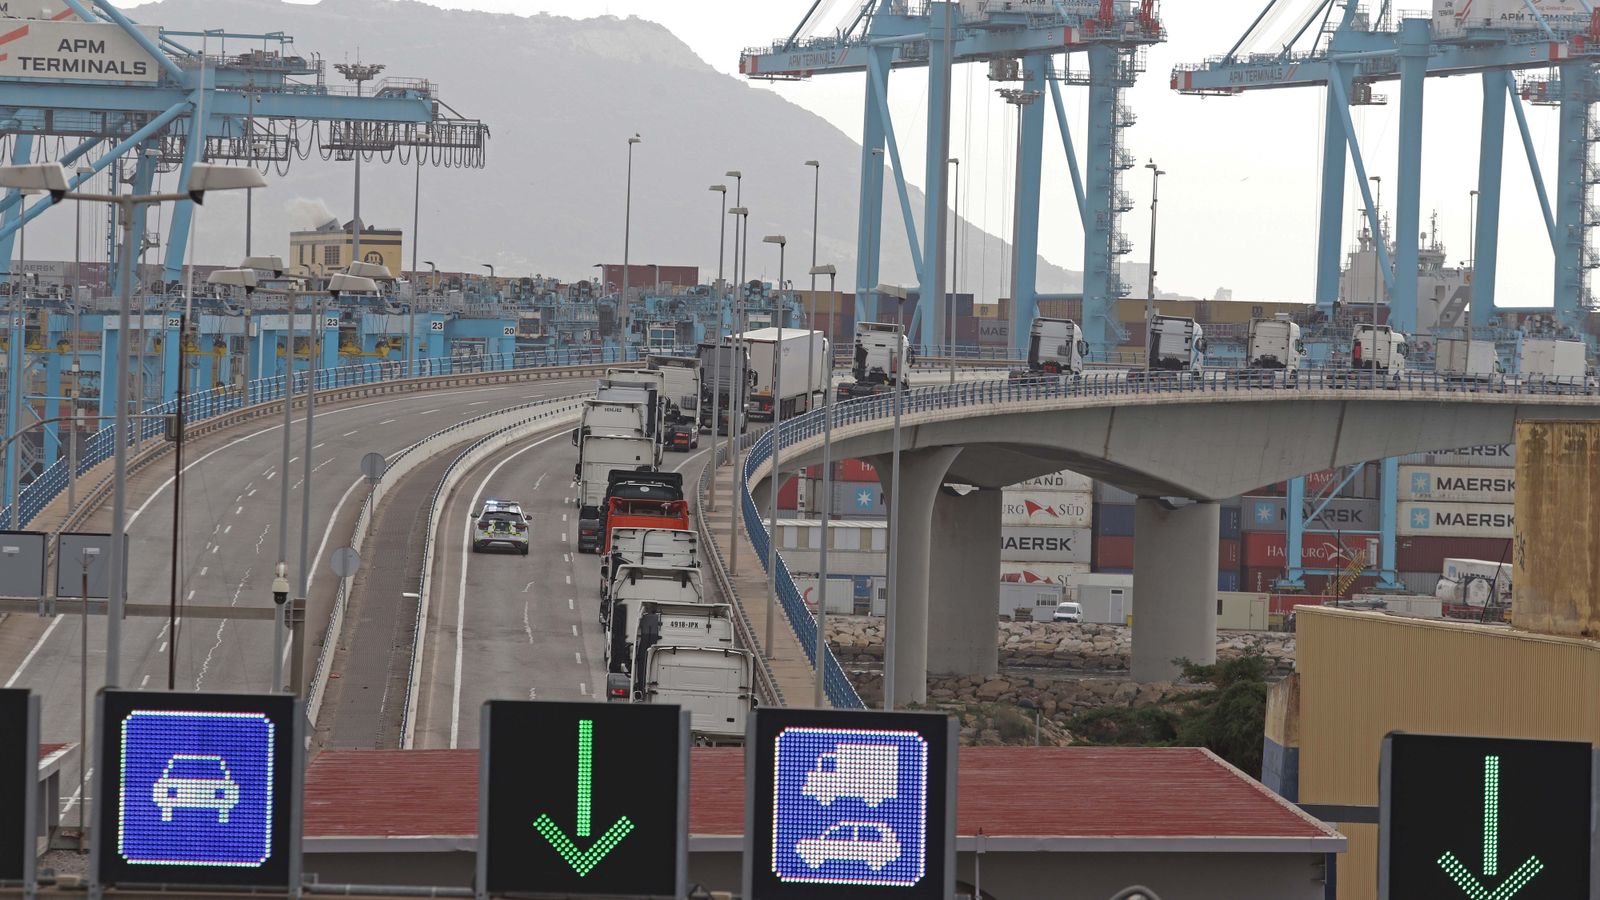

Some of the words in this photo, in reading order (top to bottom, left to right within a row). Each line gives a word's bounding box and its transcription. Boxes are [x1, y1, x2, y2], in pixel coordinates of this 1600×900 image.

[1501, 13, 1524, 21] APM
[57, 38, 105, 54] APM
[18, 56, 147, 75] TERMINALS
[327, 318, 338, 327] 23
[432, 321, 443, 330] 23
[504, 326, 515, 335] 20
[1427, 444, 1510, 457] ERSK
[1059, 503, 1084, 516] SÜD
[1001, 536, 1072, 552] AERSK
[1267, 545, 1325, 558] HAURG
